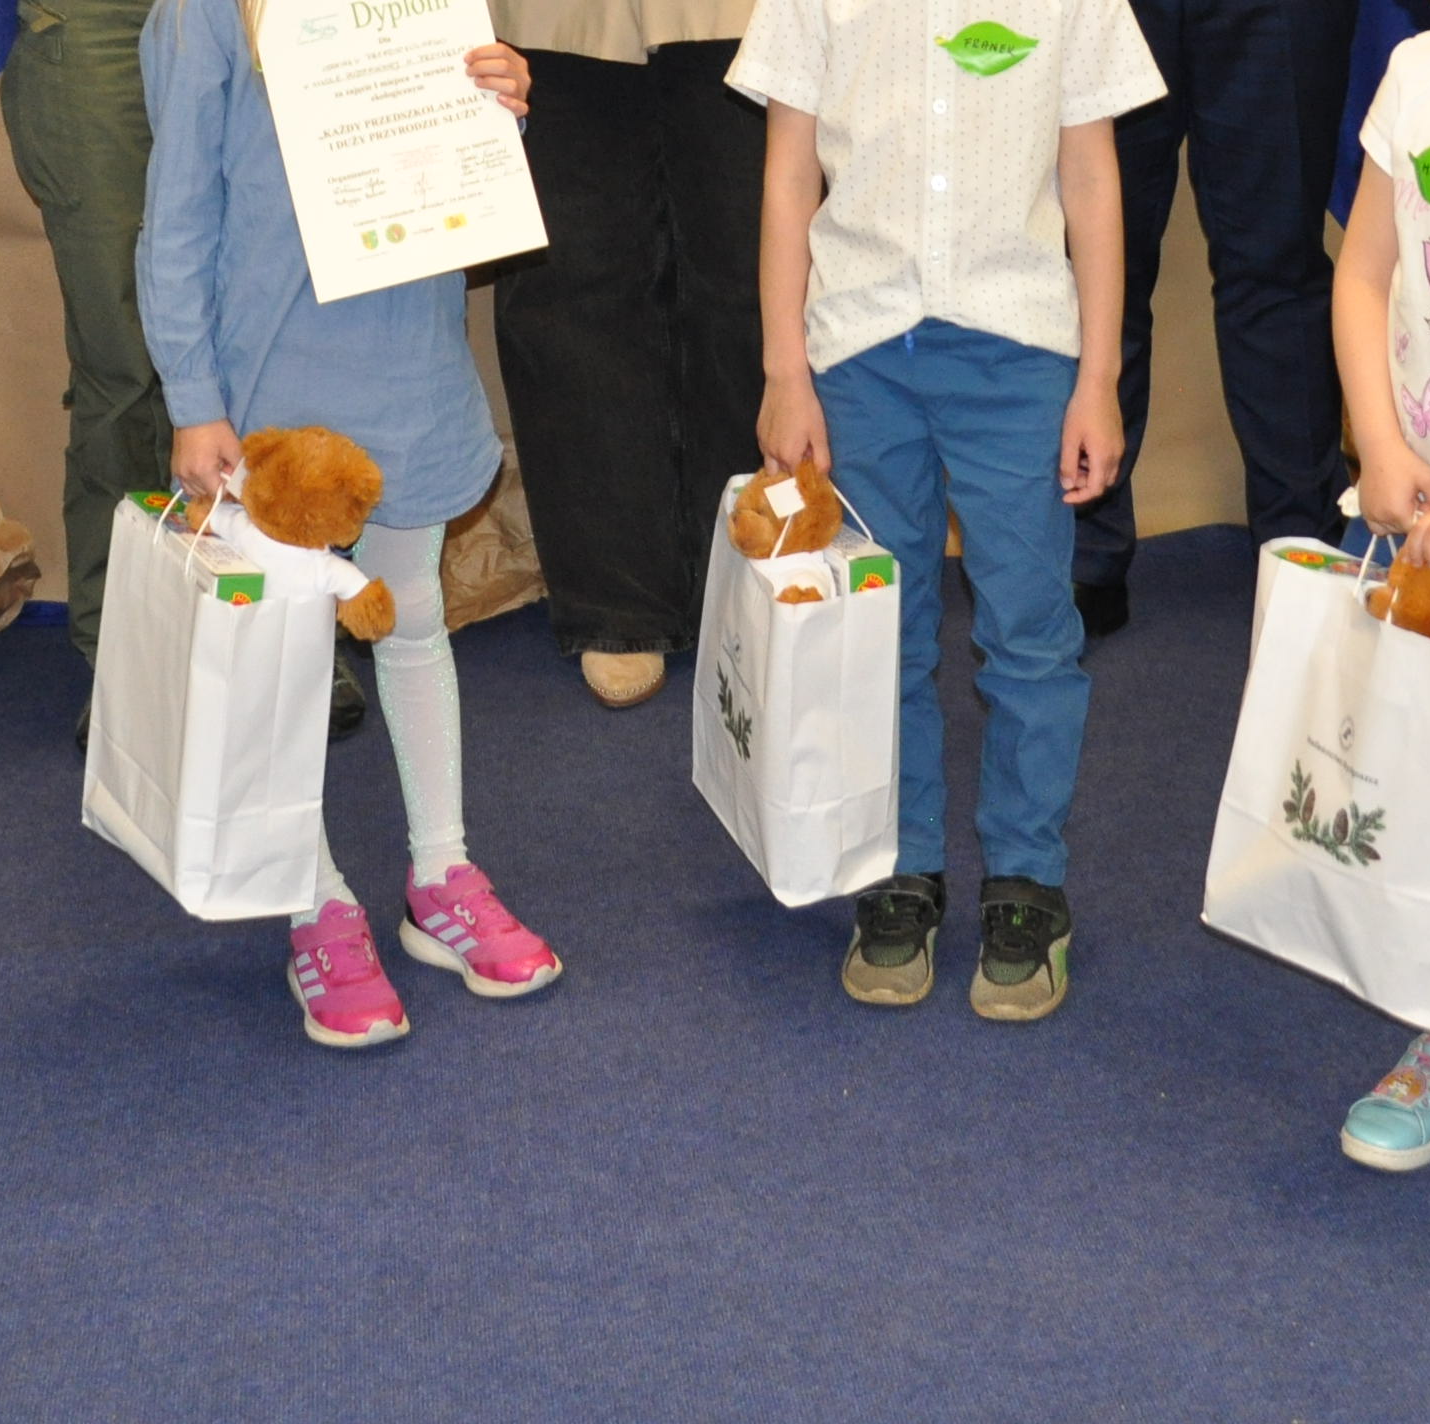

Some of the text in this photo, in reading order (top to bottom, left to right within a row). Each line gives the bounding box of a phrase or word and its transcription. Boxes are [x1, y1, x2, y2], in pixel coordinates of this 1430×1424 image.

[363, 101, 453, 128] PRZEDSZKOLAK
[335, 135, 365, 149] DUŻY
[368, 117, 438, 141] PRZYRODZIE
